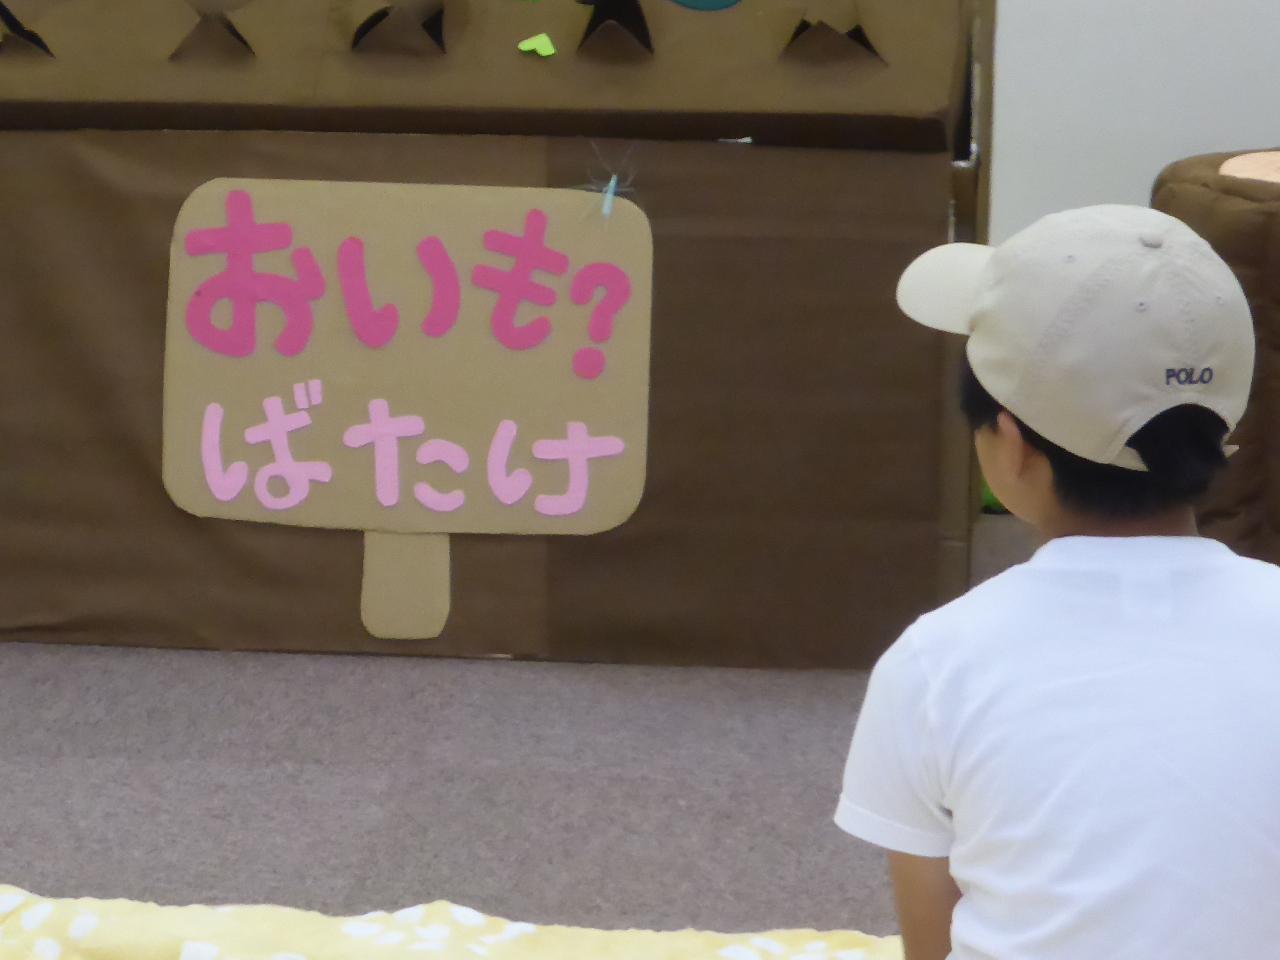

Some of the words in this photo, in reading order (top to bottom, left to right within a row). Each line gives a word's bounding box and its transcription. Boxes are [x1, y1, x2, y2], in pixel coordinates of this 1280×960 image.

[1165, 366, 1214, 386] POLO
[200, 378, 625, 516] ばたけ
